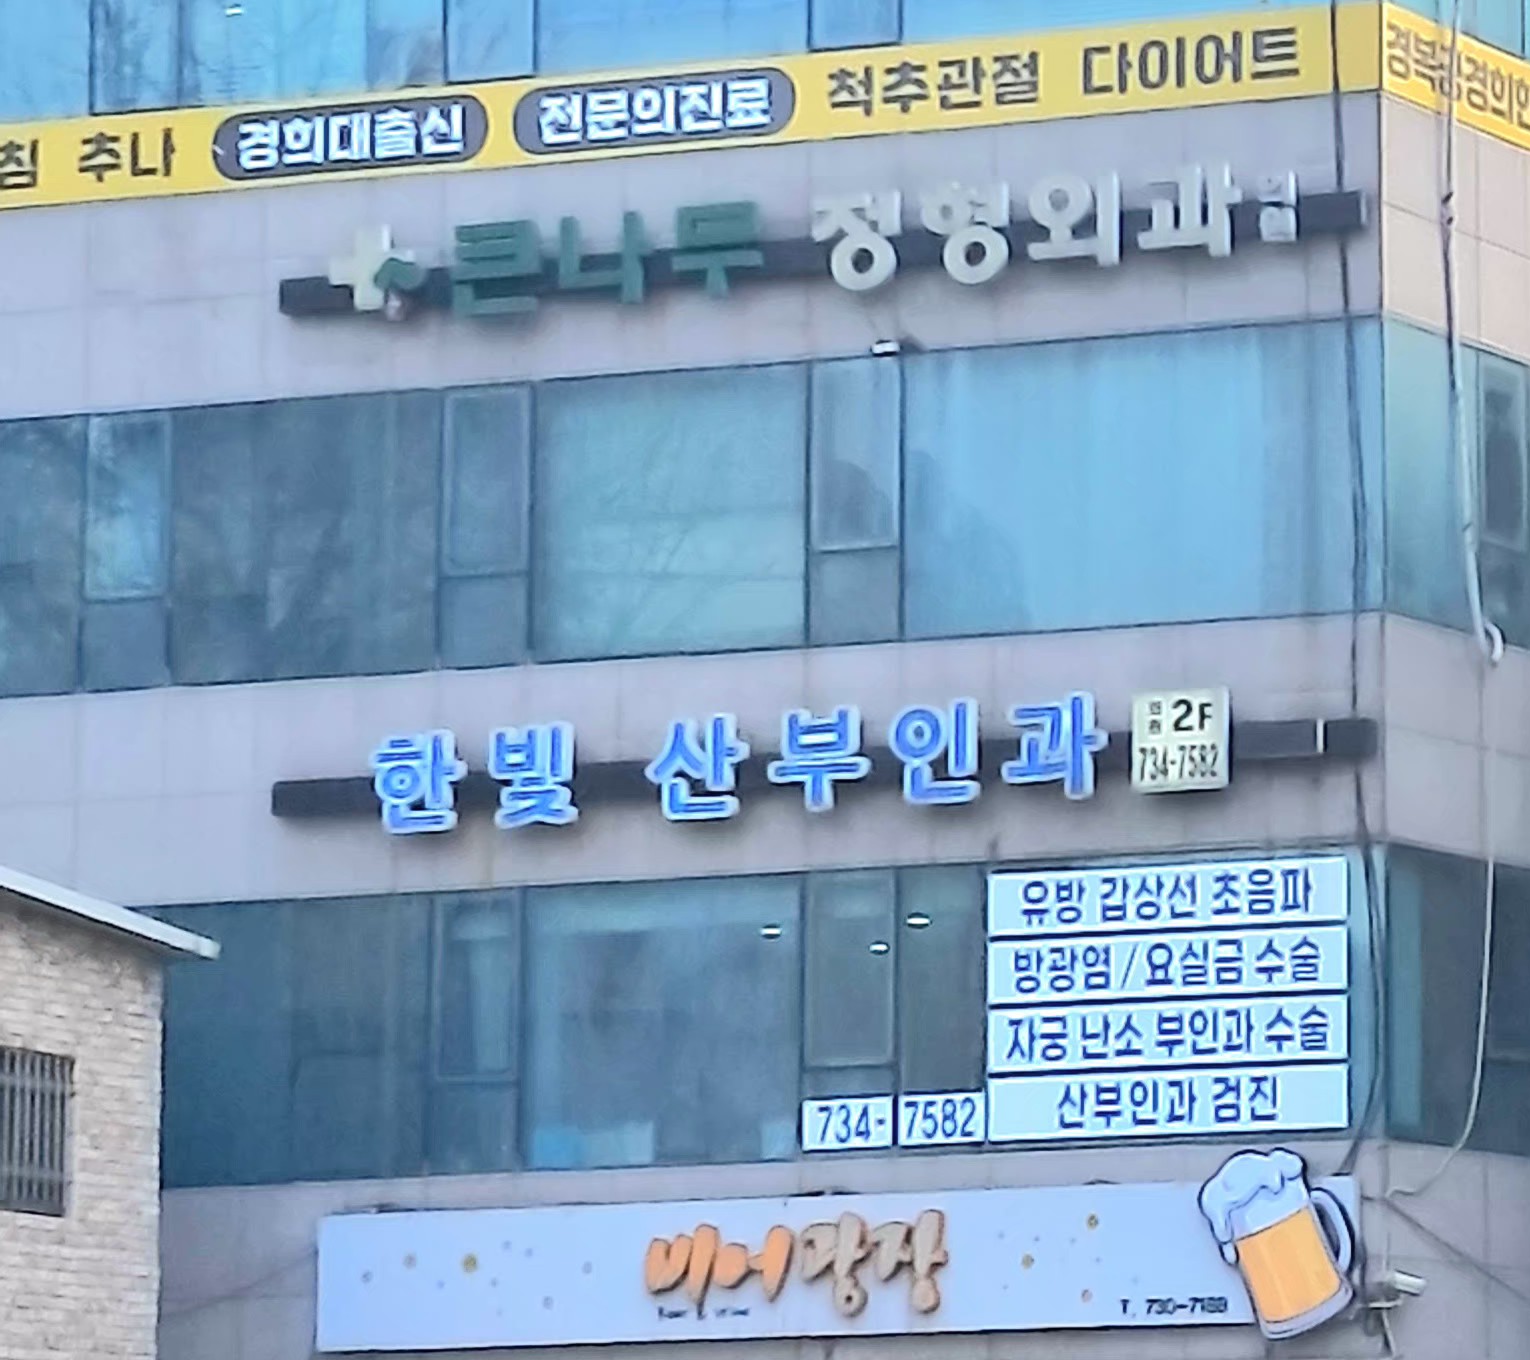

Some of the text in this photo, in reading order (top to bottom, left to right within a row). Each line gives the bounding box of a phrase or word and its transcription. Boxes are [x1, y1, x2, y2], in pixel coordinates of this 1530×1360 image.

[78, 126, 176, 183] 추나
[236, 102, 465, 173] 경희대출신
[537, 75, 773, 147] 전문의진료
[827, 49, 1041, 117] 척추관절
[1080, 25, 1301, 96] 다이어트
[810, 159, 1242, 293] 정형외과
[1171, 698, 1213, 732] 2F
[370, 689, 1109, 834] 한빛 산부인과
[1020, 867, 1313, 926] 유방 갑상선 초음파
[1253, 936, 1323, 986] 수술
[1005, 1004, 1331, 1063] 자궁 난소 부인과 수술
[903, 1097, 978, 1140] 7582
[1056, 1075, 1280, 1130] 산부인과 검진
